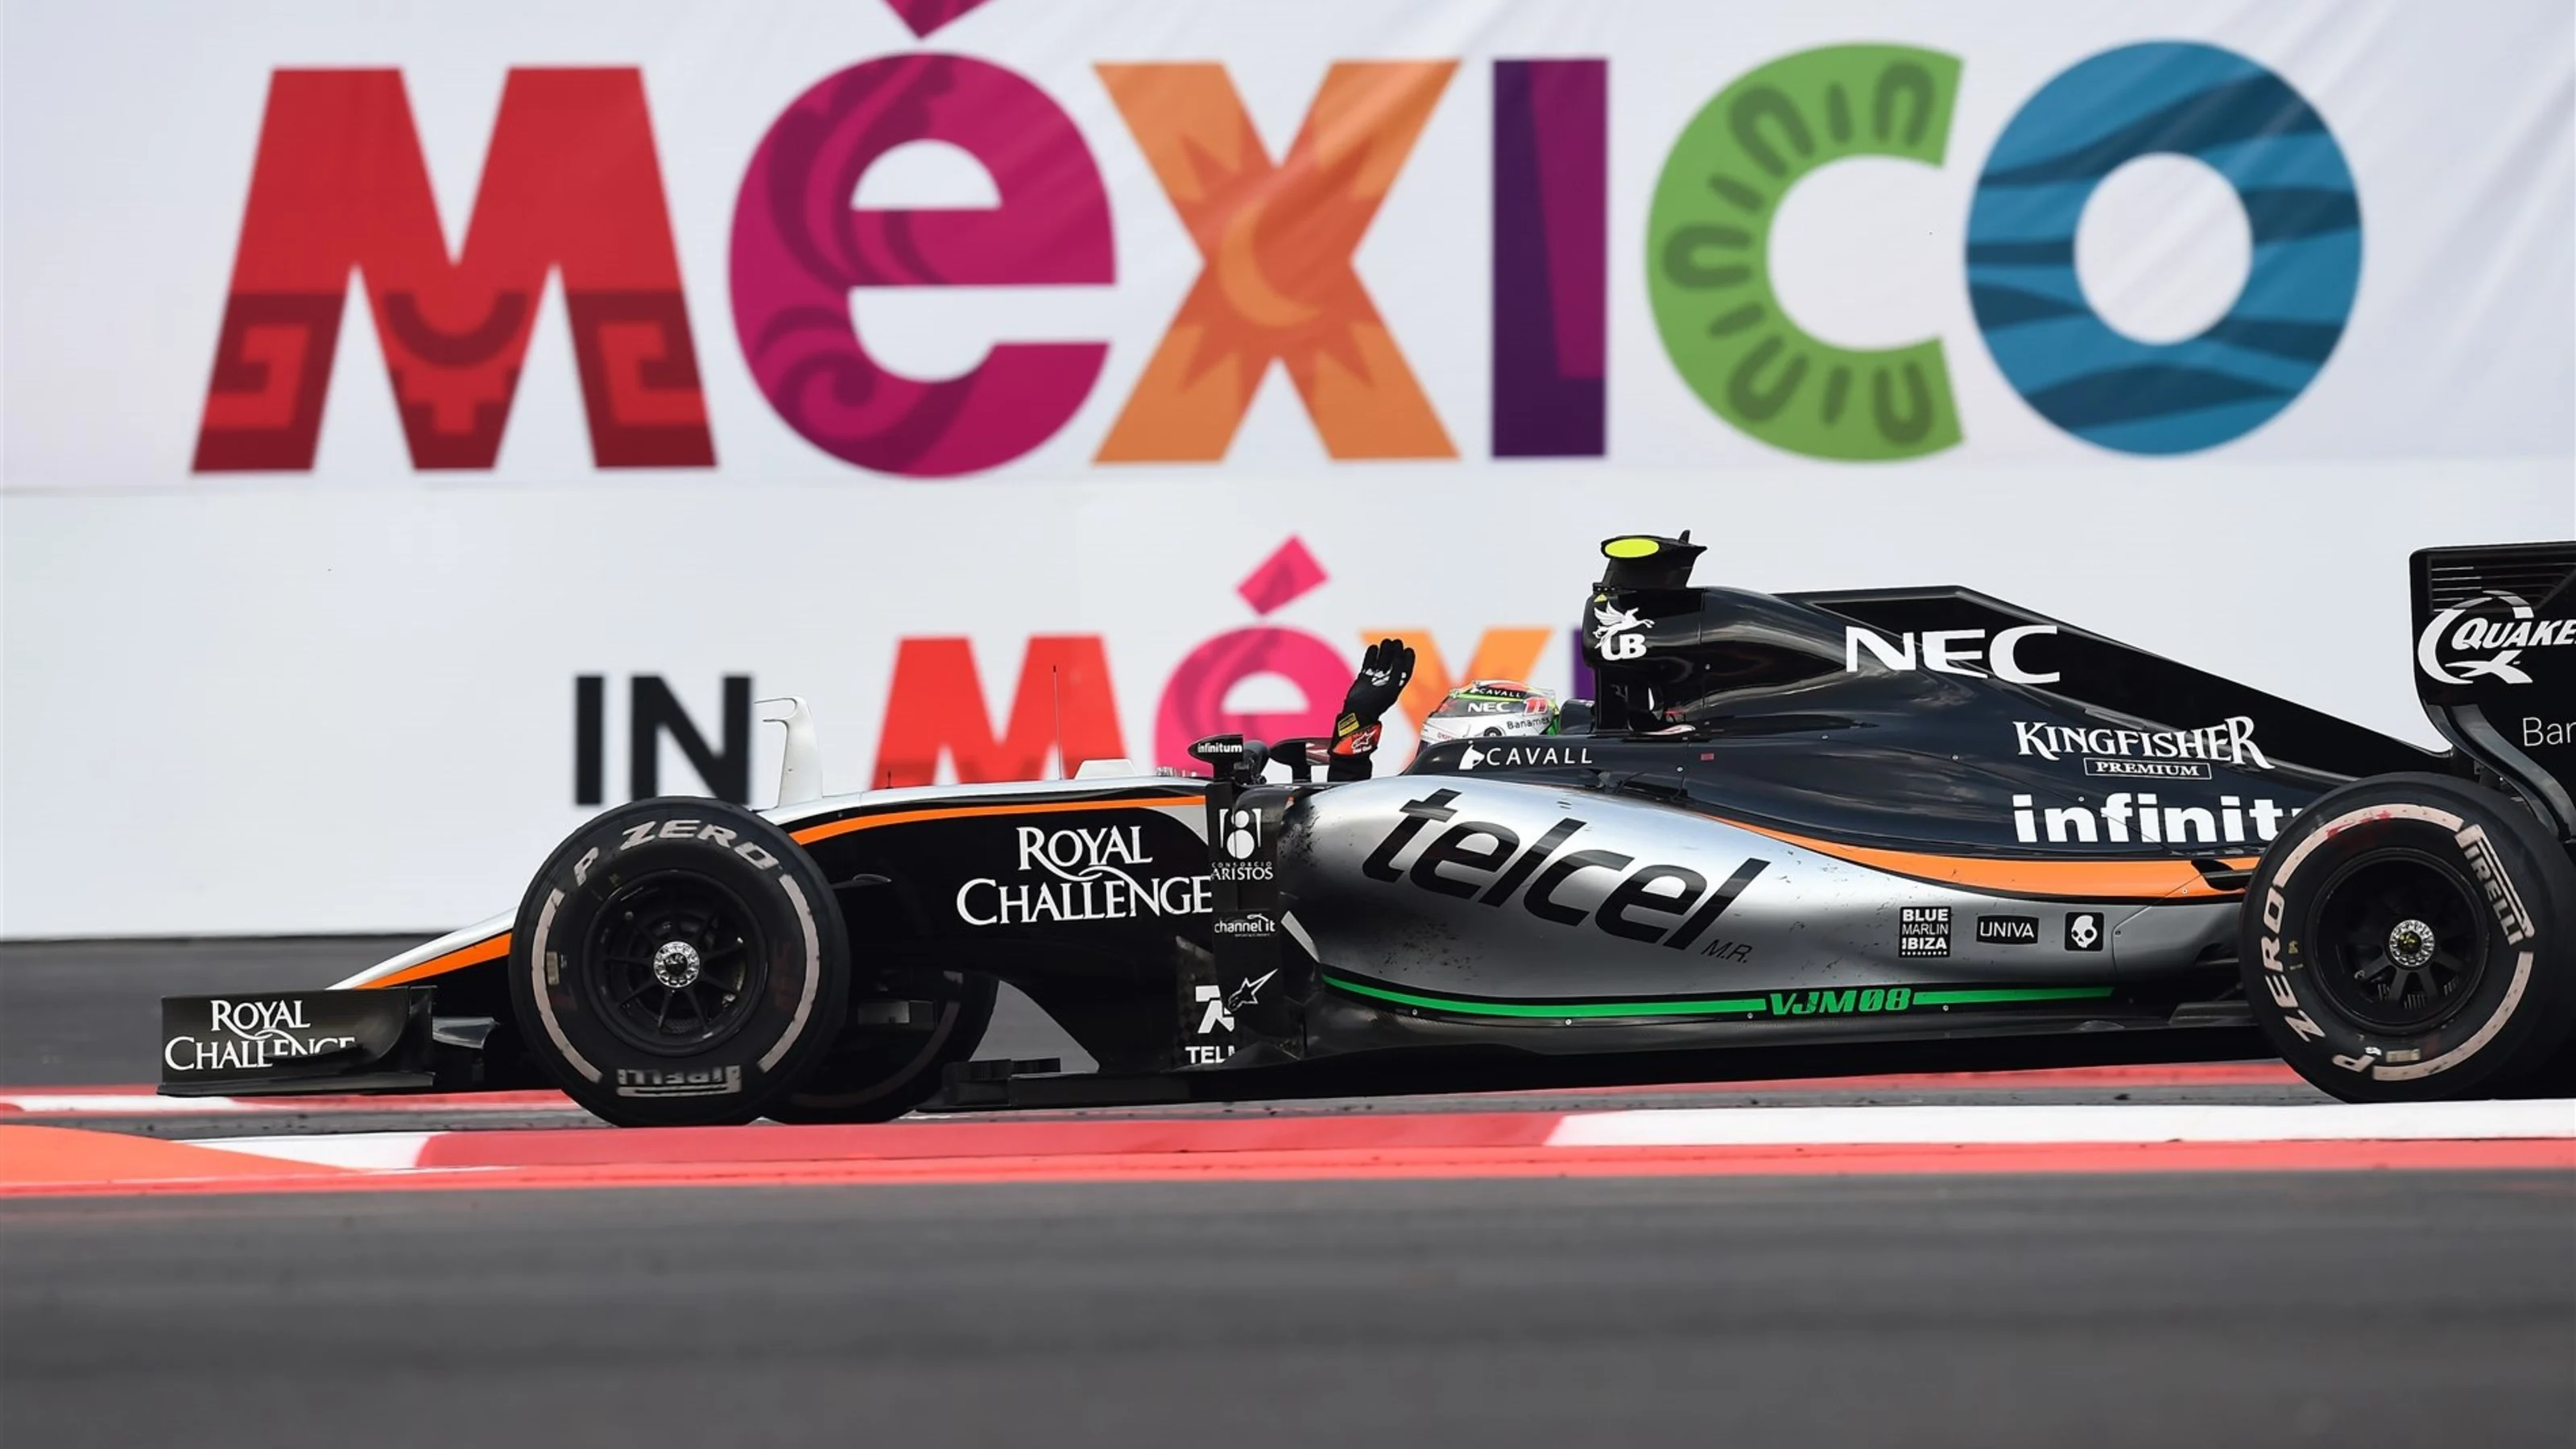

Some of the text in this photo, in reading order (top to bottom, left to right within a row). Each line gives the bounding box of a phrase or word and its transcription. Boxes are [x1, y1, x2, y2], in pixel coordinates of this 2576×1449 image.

[2451, 617, 2576, 650] QUAKE
[1846, 625, 2060, 683] NEC
[1467, 702, 1511, 713] NEC
[1479, 689, 1521, 699] CAVALL
[1507, 717, 1550, 730] Banamex
[573, 673, 752, 807] IN
[1197, 742, 1243, 753] infinitum
[2012, 716, 2276, 769] KINGFISHER
[1486, 747, 1593, 766] CAVALL
[2096, 762, 2200, 777] PREMIUM
[2012, 792, 2303, 843] infinit
[620, 819, 780, 870] ZERO
[1016, 826, 1153, 881] ROYAL
[1211, 868, 1274, 881] ARISTOS
[1362, 788, 1772, 950] telcel
[956, 866, 1213, 925] CHALLENGE
[2454, 824, 2535, 946] PIRELLI
[1214, 920, 1276, 933] channel it
[1901, 923, 1949, 935] MARLIN
[1902, 909, 1949, 922] BLUE
[1979, 922, 2035, 938] UNIVA
[1701, 939, 1753, 964] M.R.
[2260, 886, 2326, 1042] ZERO
[1769, 987, 1912, 1016] VJM08
[210, 1000, 311, 1039] ROYAL
